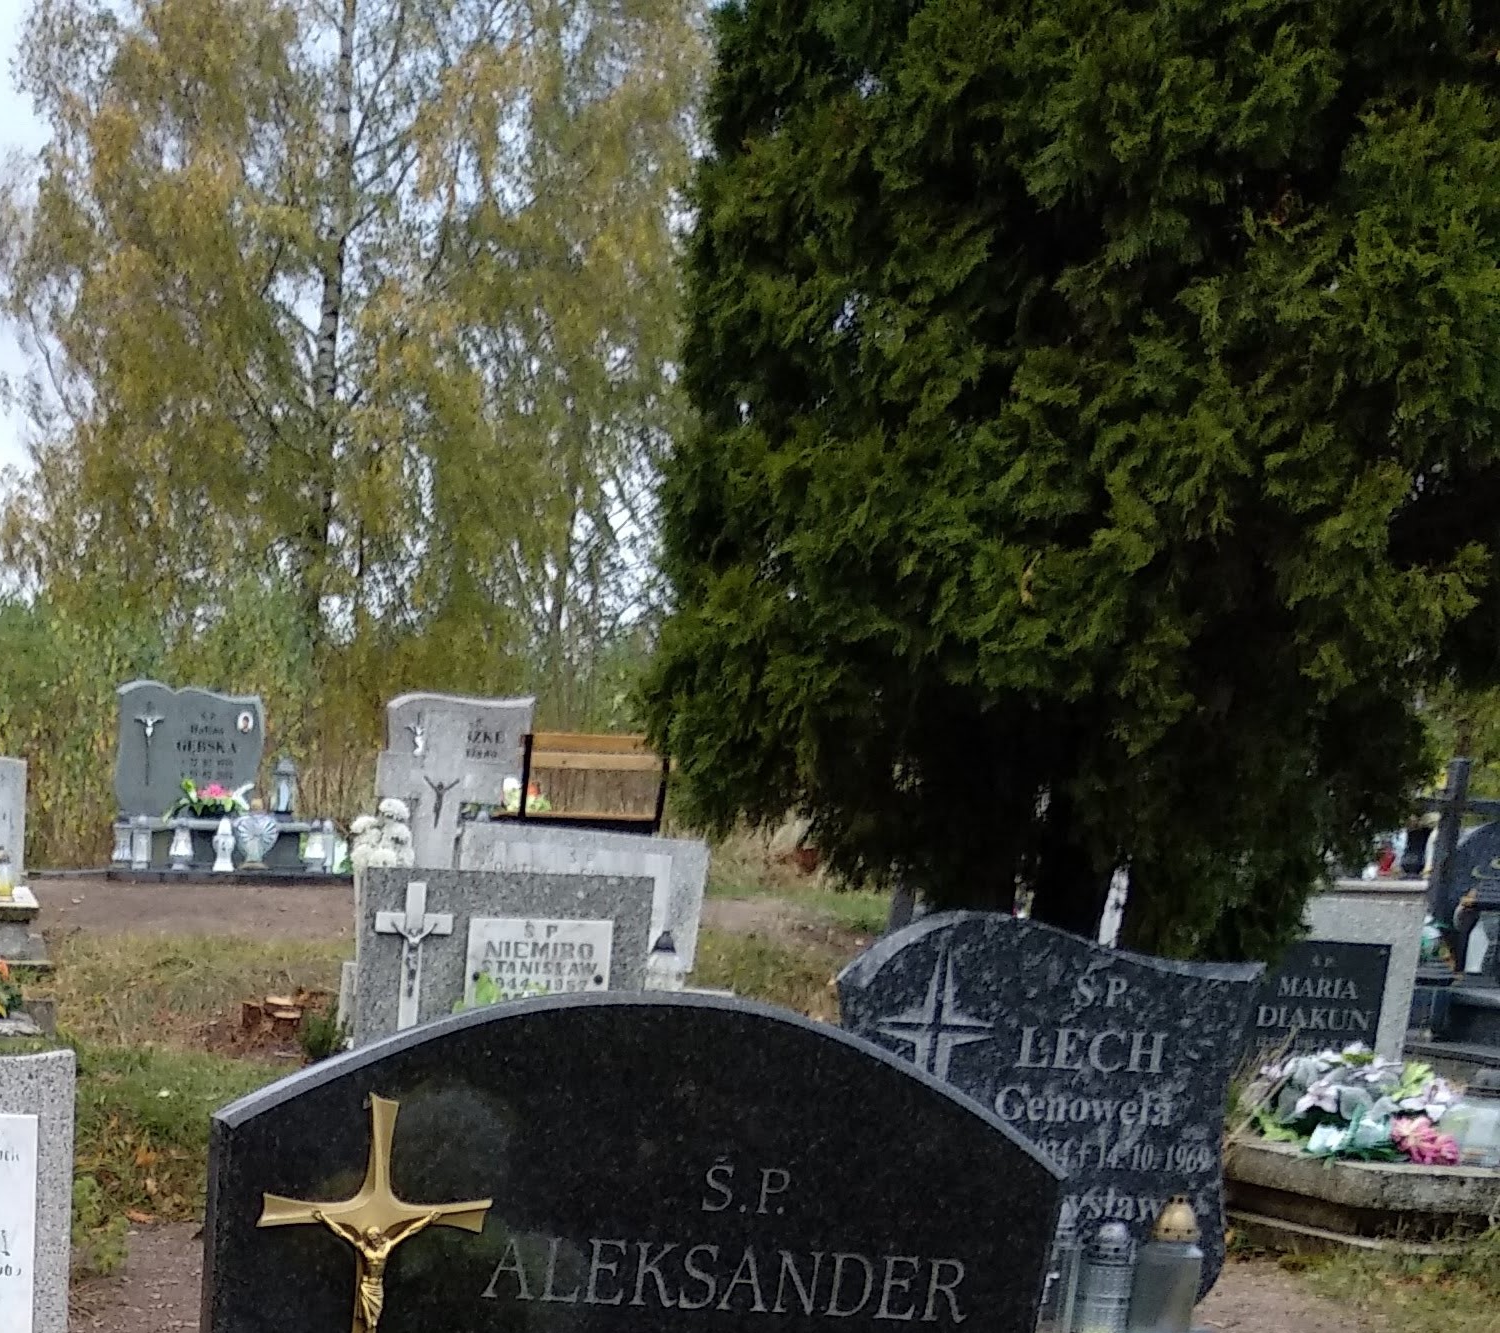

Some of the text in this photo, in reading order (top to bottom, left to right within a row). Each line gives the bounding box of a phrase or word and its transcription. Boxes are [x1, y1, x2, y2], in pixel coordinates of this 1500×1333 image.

[484, 941, 594, 959] NIEMIRO
[482, 960, 598, 976] STANISŁAW
[1277, 976, 1358, 1000] MARIA
[1256, 1005, 1376, 1031] DIAKUN
[1014, 1026, 1168, 1074] LECH
[995, 1084, 1174, 1127] Genowefa
[481, 1236, 967, 1324] ALEKSANDER
